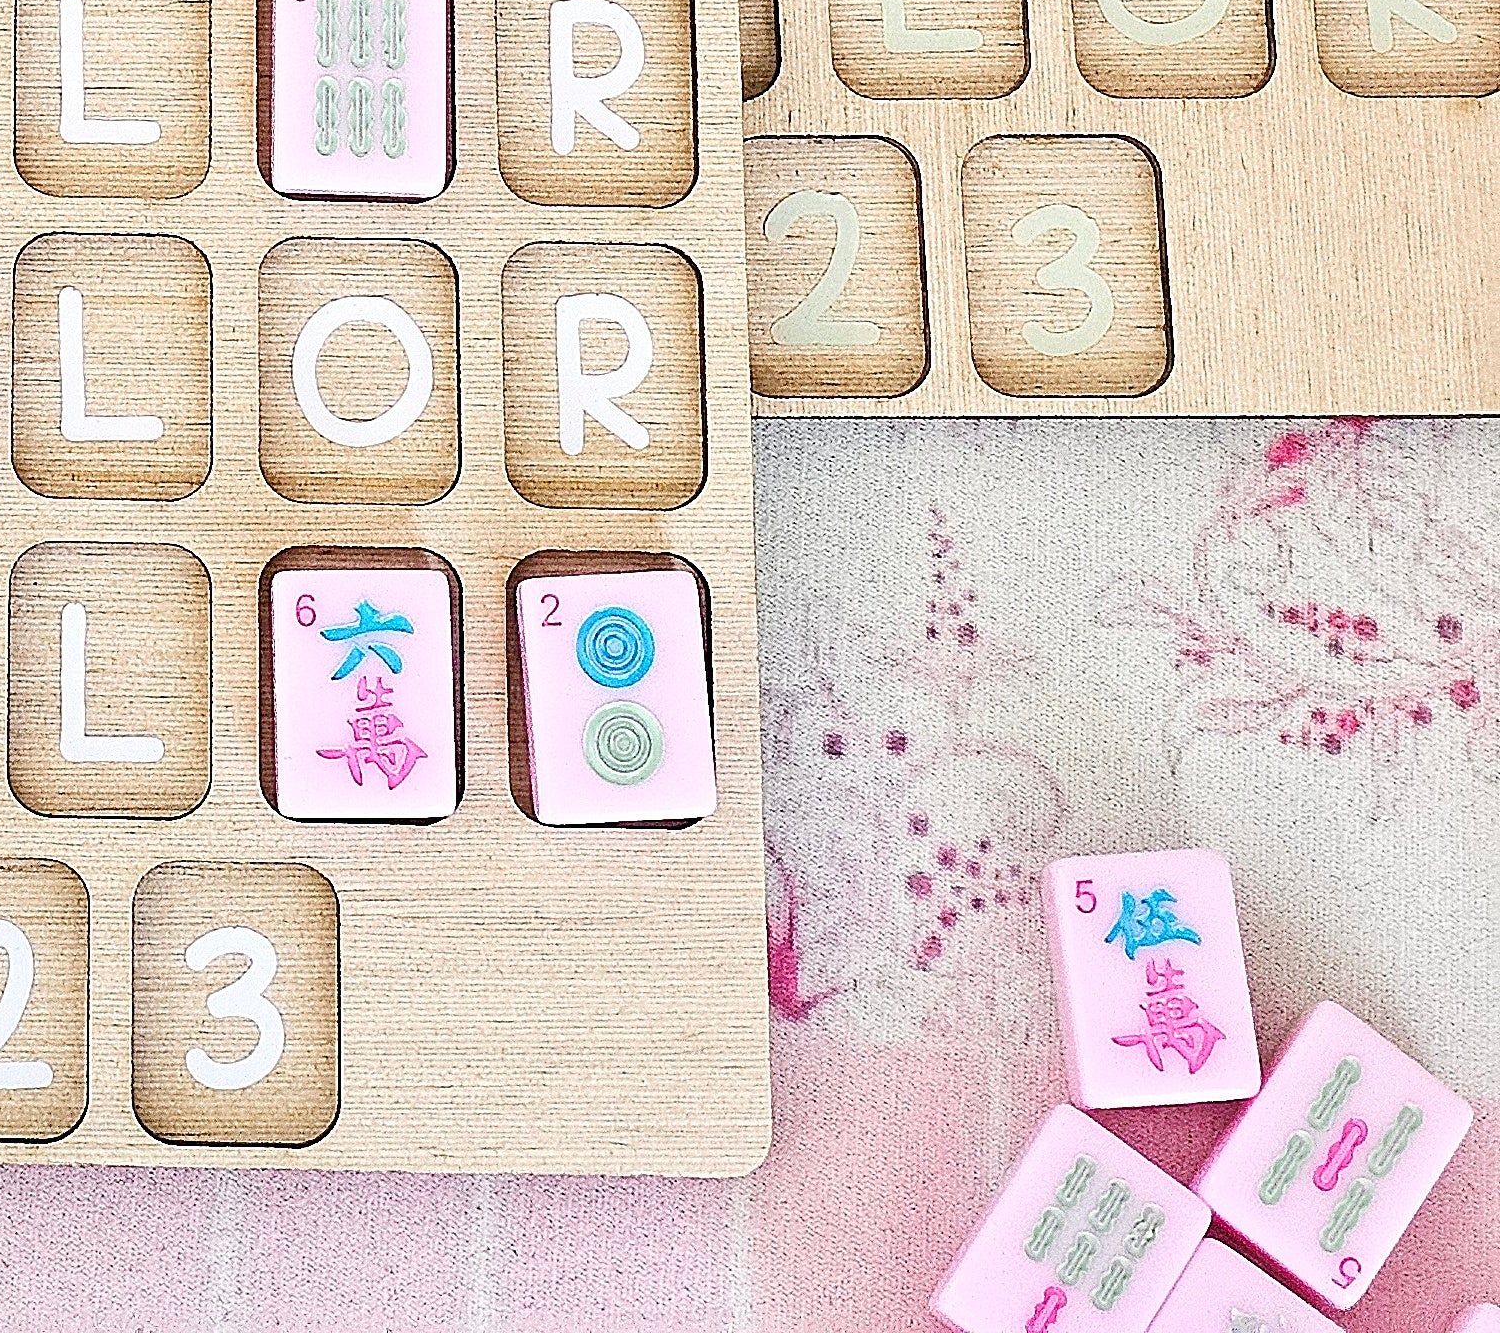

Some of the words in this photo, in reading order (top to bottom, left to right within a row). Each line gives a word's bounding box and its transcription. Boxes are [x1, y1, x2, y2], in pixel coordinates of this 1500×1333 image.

[1010, 204, 1116, 358] 3
[294, 593, 318, 628] 6
[540, 592, 564, 627] 2
[1074, 879, 1098, 914] 5
[184, 924, 286, 1091] 3
[1330, 1255, 1364, 1290] 5
